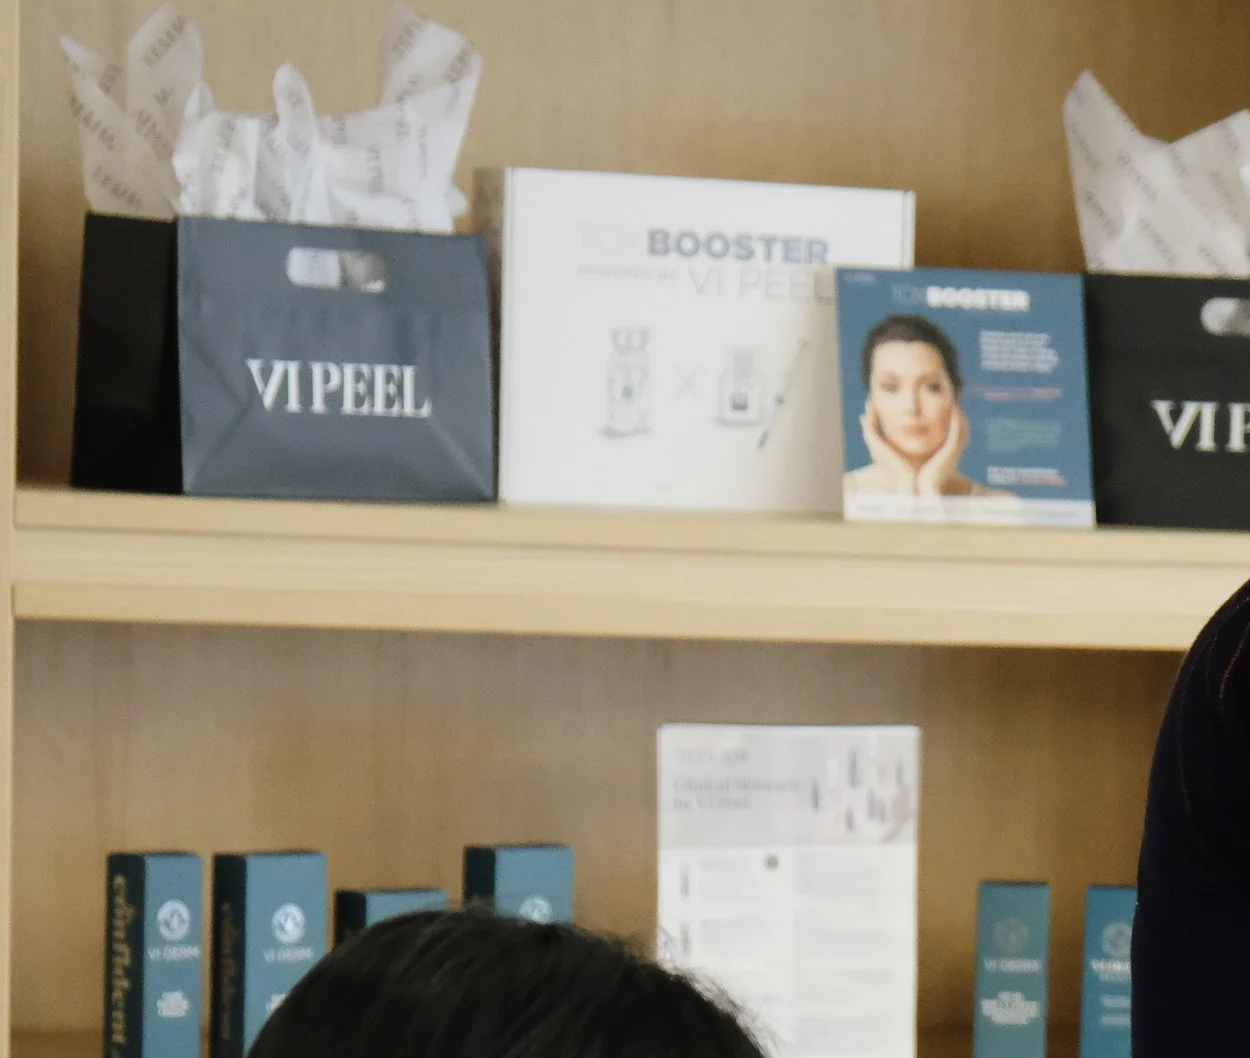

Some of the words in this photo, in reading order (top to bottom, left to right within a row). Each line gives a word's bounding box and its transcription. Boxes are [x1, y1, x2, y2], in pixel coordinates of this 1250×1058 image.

[646, 227, 829, 264] BOOSTER
[926, 286, 1032, 312] BOOSTER
[245, 358, 301, 414] VI
[311, 360, 433, 419] PEEL
[1151, 400, 1219, 453] VI
